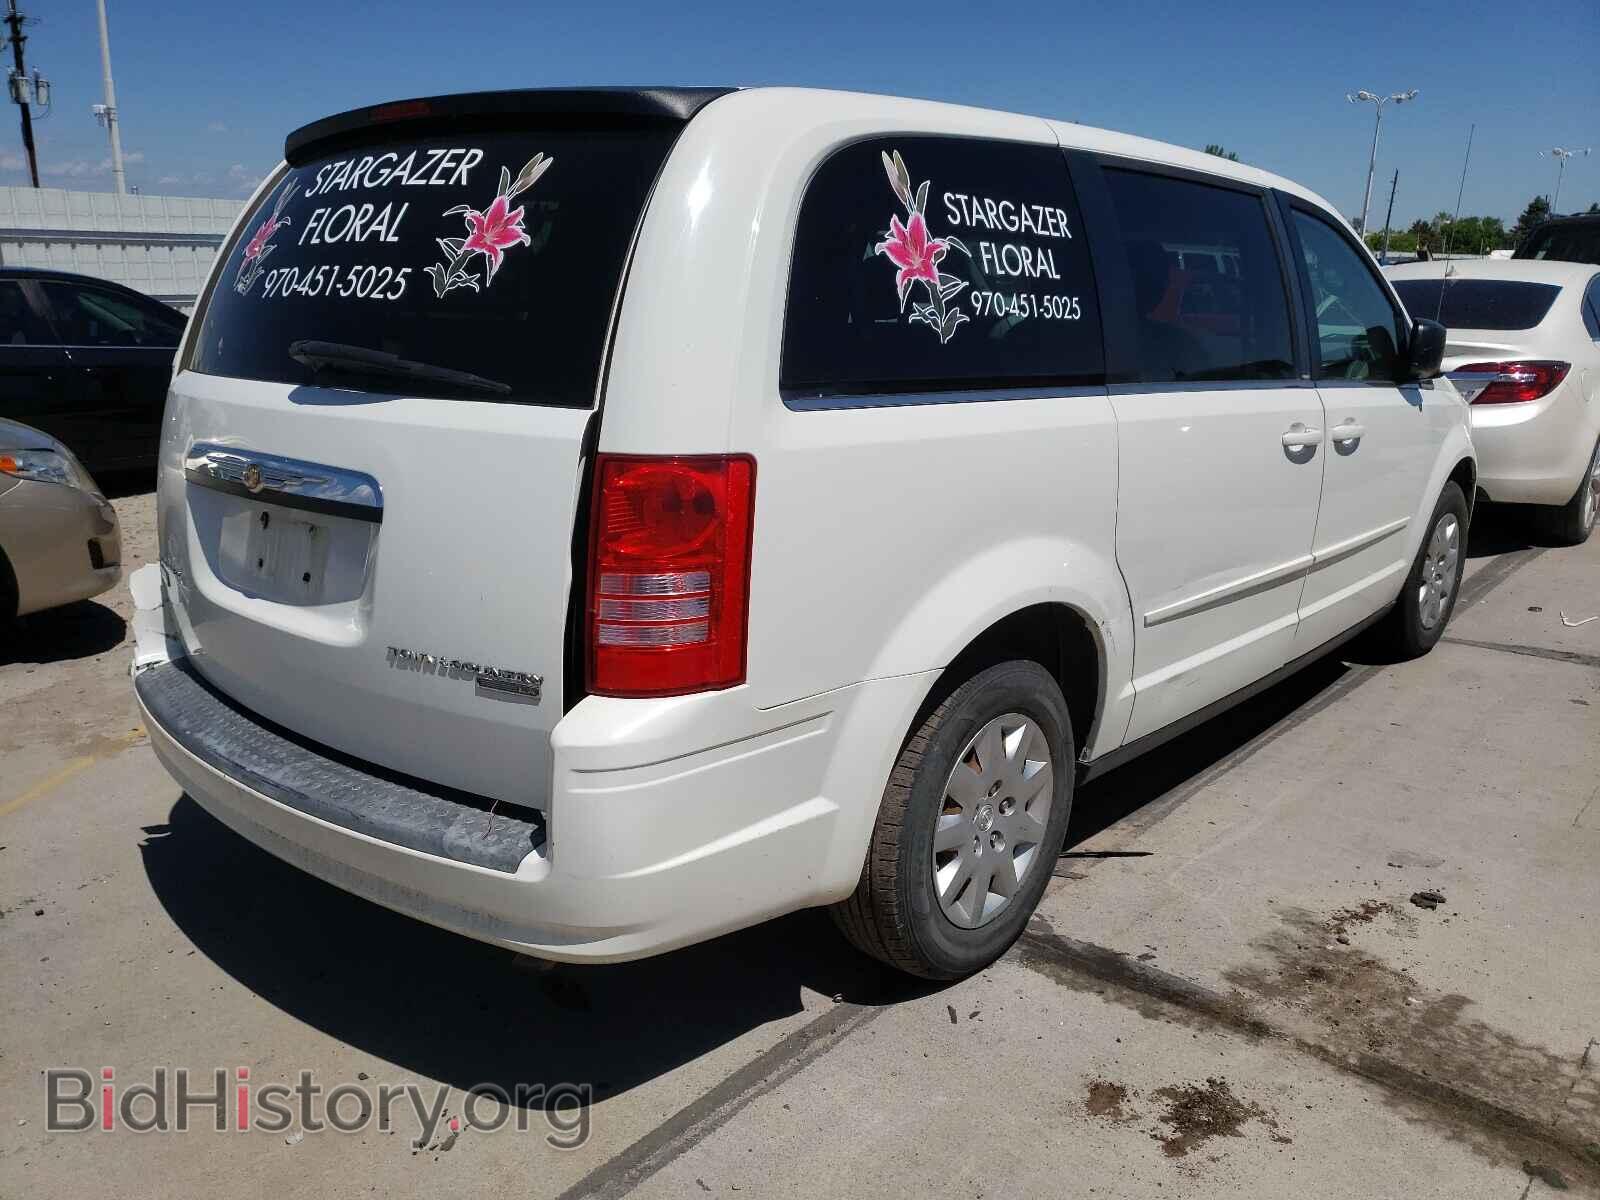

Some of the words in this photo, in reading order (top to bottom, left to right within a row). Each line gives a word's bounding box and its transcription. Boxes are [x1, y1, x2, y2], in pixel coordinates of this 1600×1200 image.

[304, 148, 484, 198] STARGAZER
[298, 201, 409, 246] FLORAL
[943, 191, 1073, 239] STARGAZER
[979, 241, 1061, 280] FLORAL
[261, 265, 413, 300] 970-451-5025
[970, 290, 1081, 320] 970-451-5025
